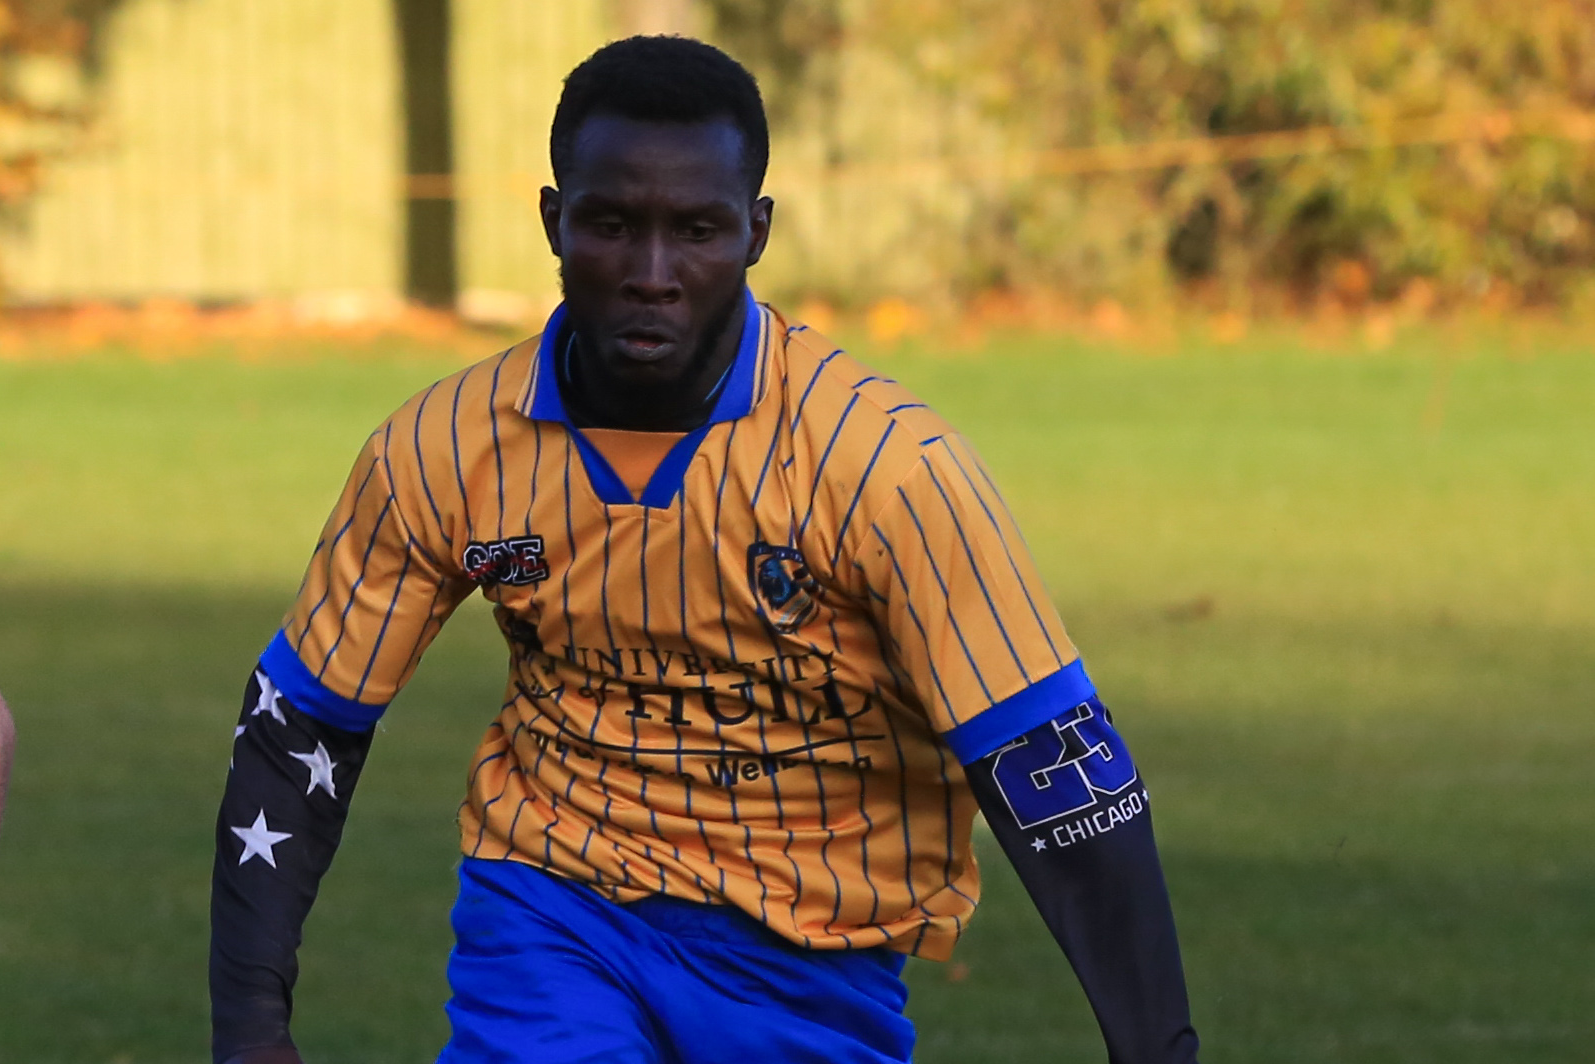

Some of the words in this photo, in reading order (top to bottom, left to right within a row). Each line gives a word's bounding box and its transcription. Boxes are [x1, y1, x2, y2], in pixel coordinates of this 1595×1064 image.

[624, 677, 873, 726] HULL
[984, 700, 1137, 830] 23
[1052, 791, 1143, 848] CHICAGO
